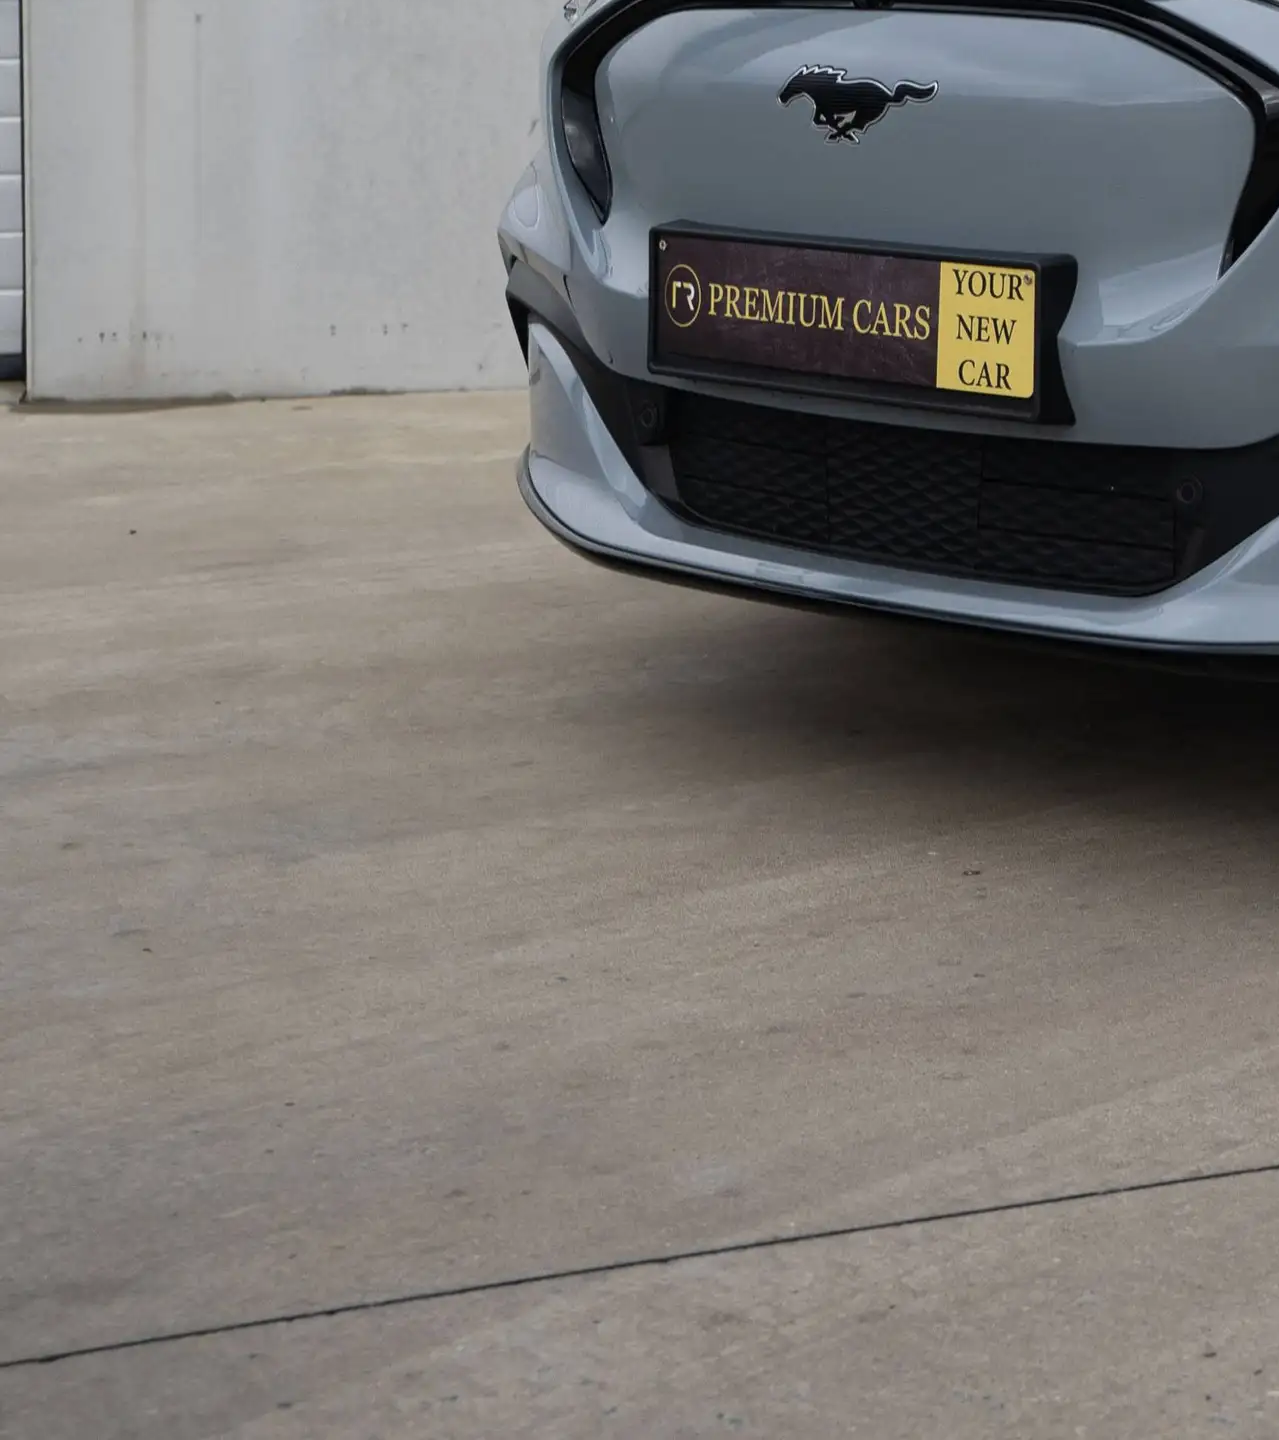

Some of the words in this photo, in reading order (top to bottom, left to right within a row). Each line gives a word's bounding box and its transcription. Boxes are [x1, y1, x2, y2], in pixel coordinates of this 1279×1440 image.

[952, 268, 1025, 301] YOUR
[707, 282, 845, 332] PREMIUM
[852, 298, 932, 341] CARS
[956, 314, 1017, 346] NEW
[957, 359, 1013, 391] CAR
